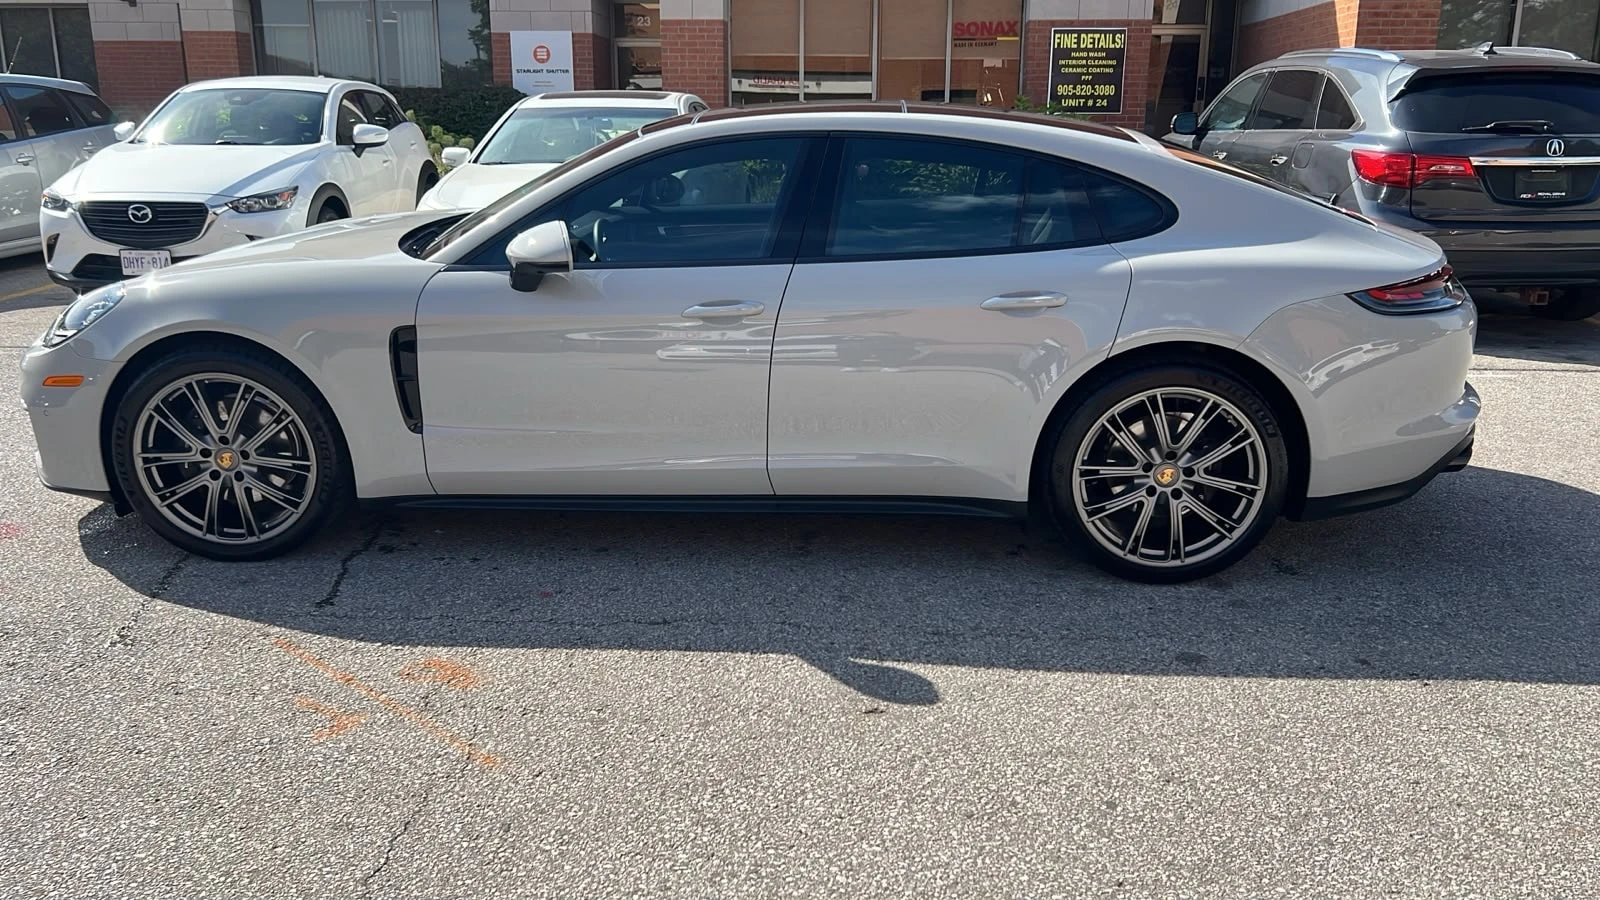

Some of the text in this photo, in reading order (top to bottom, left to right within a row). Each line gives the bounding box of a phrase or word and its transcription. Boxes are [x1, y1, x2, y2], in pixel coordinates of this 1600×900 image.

[637, 16, 651, 27] 23
[954, 20, 1019, 37] SONAX
[1054, 33, 1124, 49] FINE DETAILS!
[1057, 84, 1116, 96] 905-820-3080
[1061, 98, 1108, 107] UNIT # 24
[122, 256, 145, 269] DHYF
